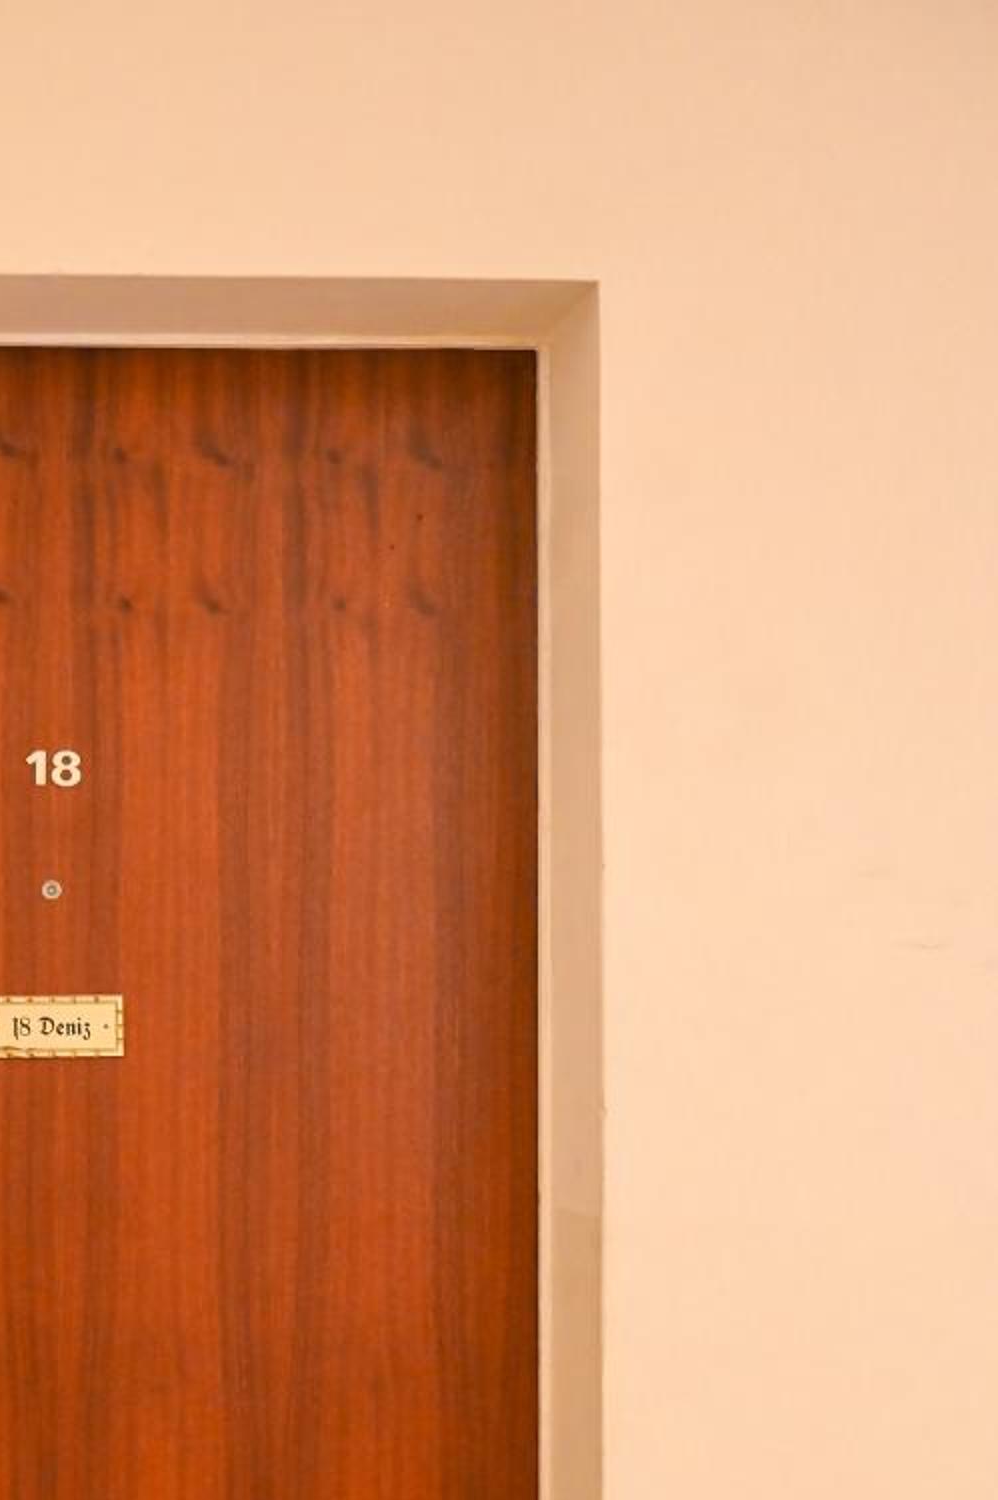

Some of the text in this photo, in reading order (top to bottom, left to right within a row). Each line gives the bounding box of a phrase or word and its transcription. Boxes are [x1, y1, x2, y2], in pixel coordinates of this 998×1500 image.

[25, 750, 82, 787] 18
[12, 1016, 91, 1041] 18 Deniz
